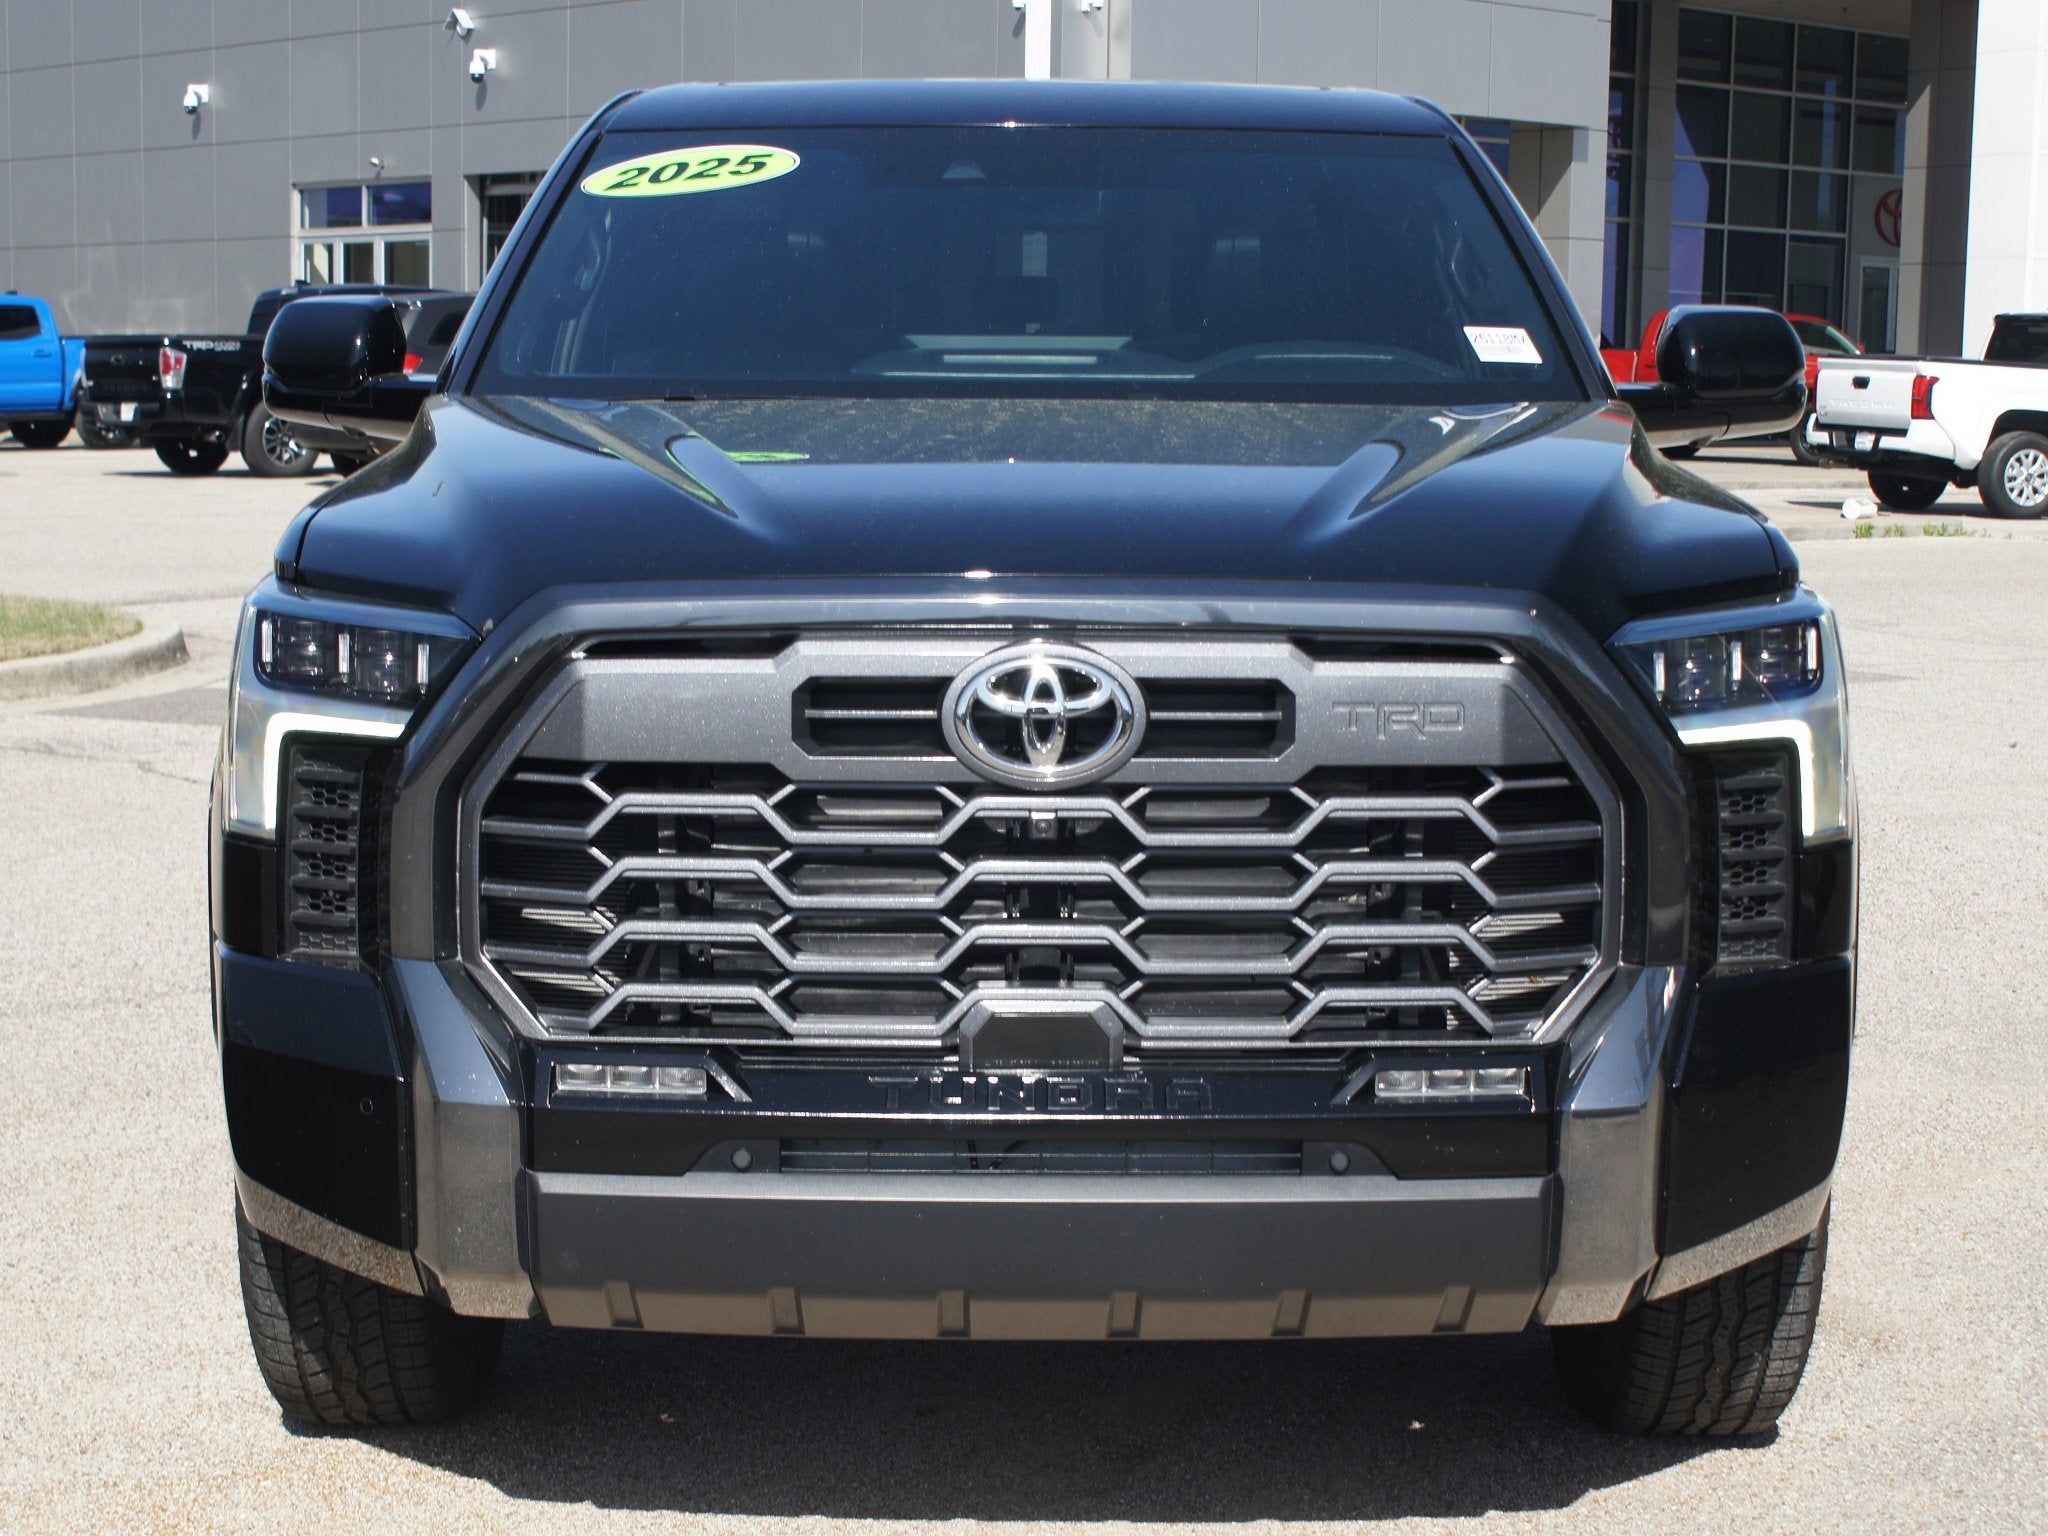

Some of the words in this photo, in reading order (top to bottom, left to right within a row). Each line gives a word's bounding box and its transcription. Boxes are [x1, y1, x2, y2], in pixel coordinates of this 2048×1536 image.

[603, 153, 774, 192] 2025
[1332, 701, 1466, 740] TRD
[868, 1076, 1212, 1110] TUNDRA
